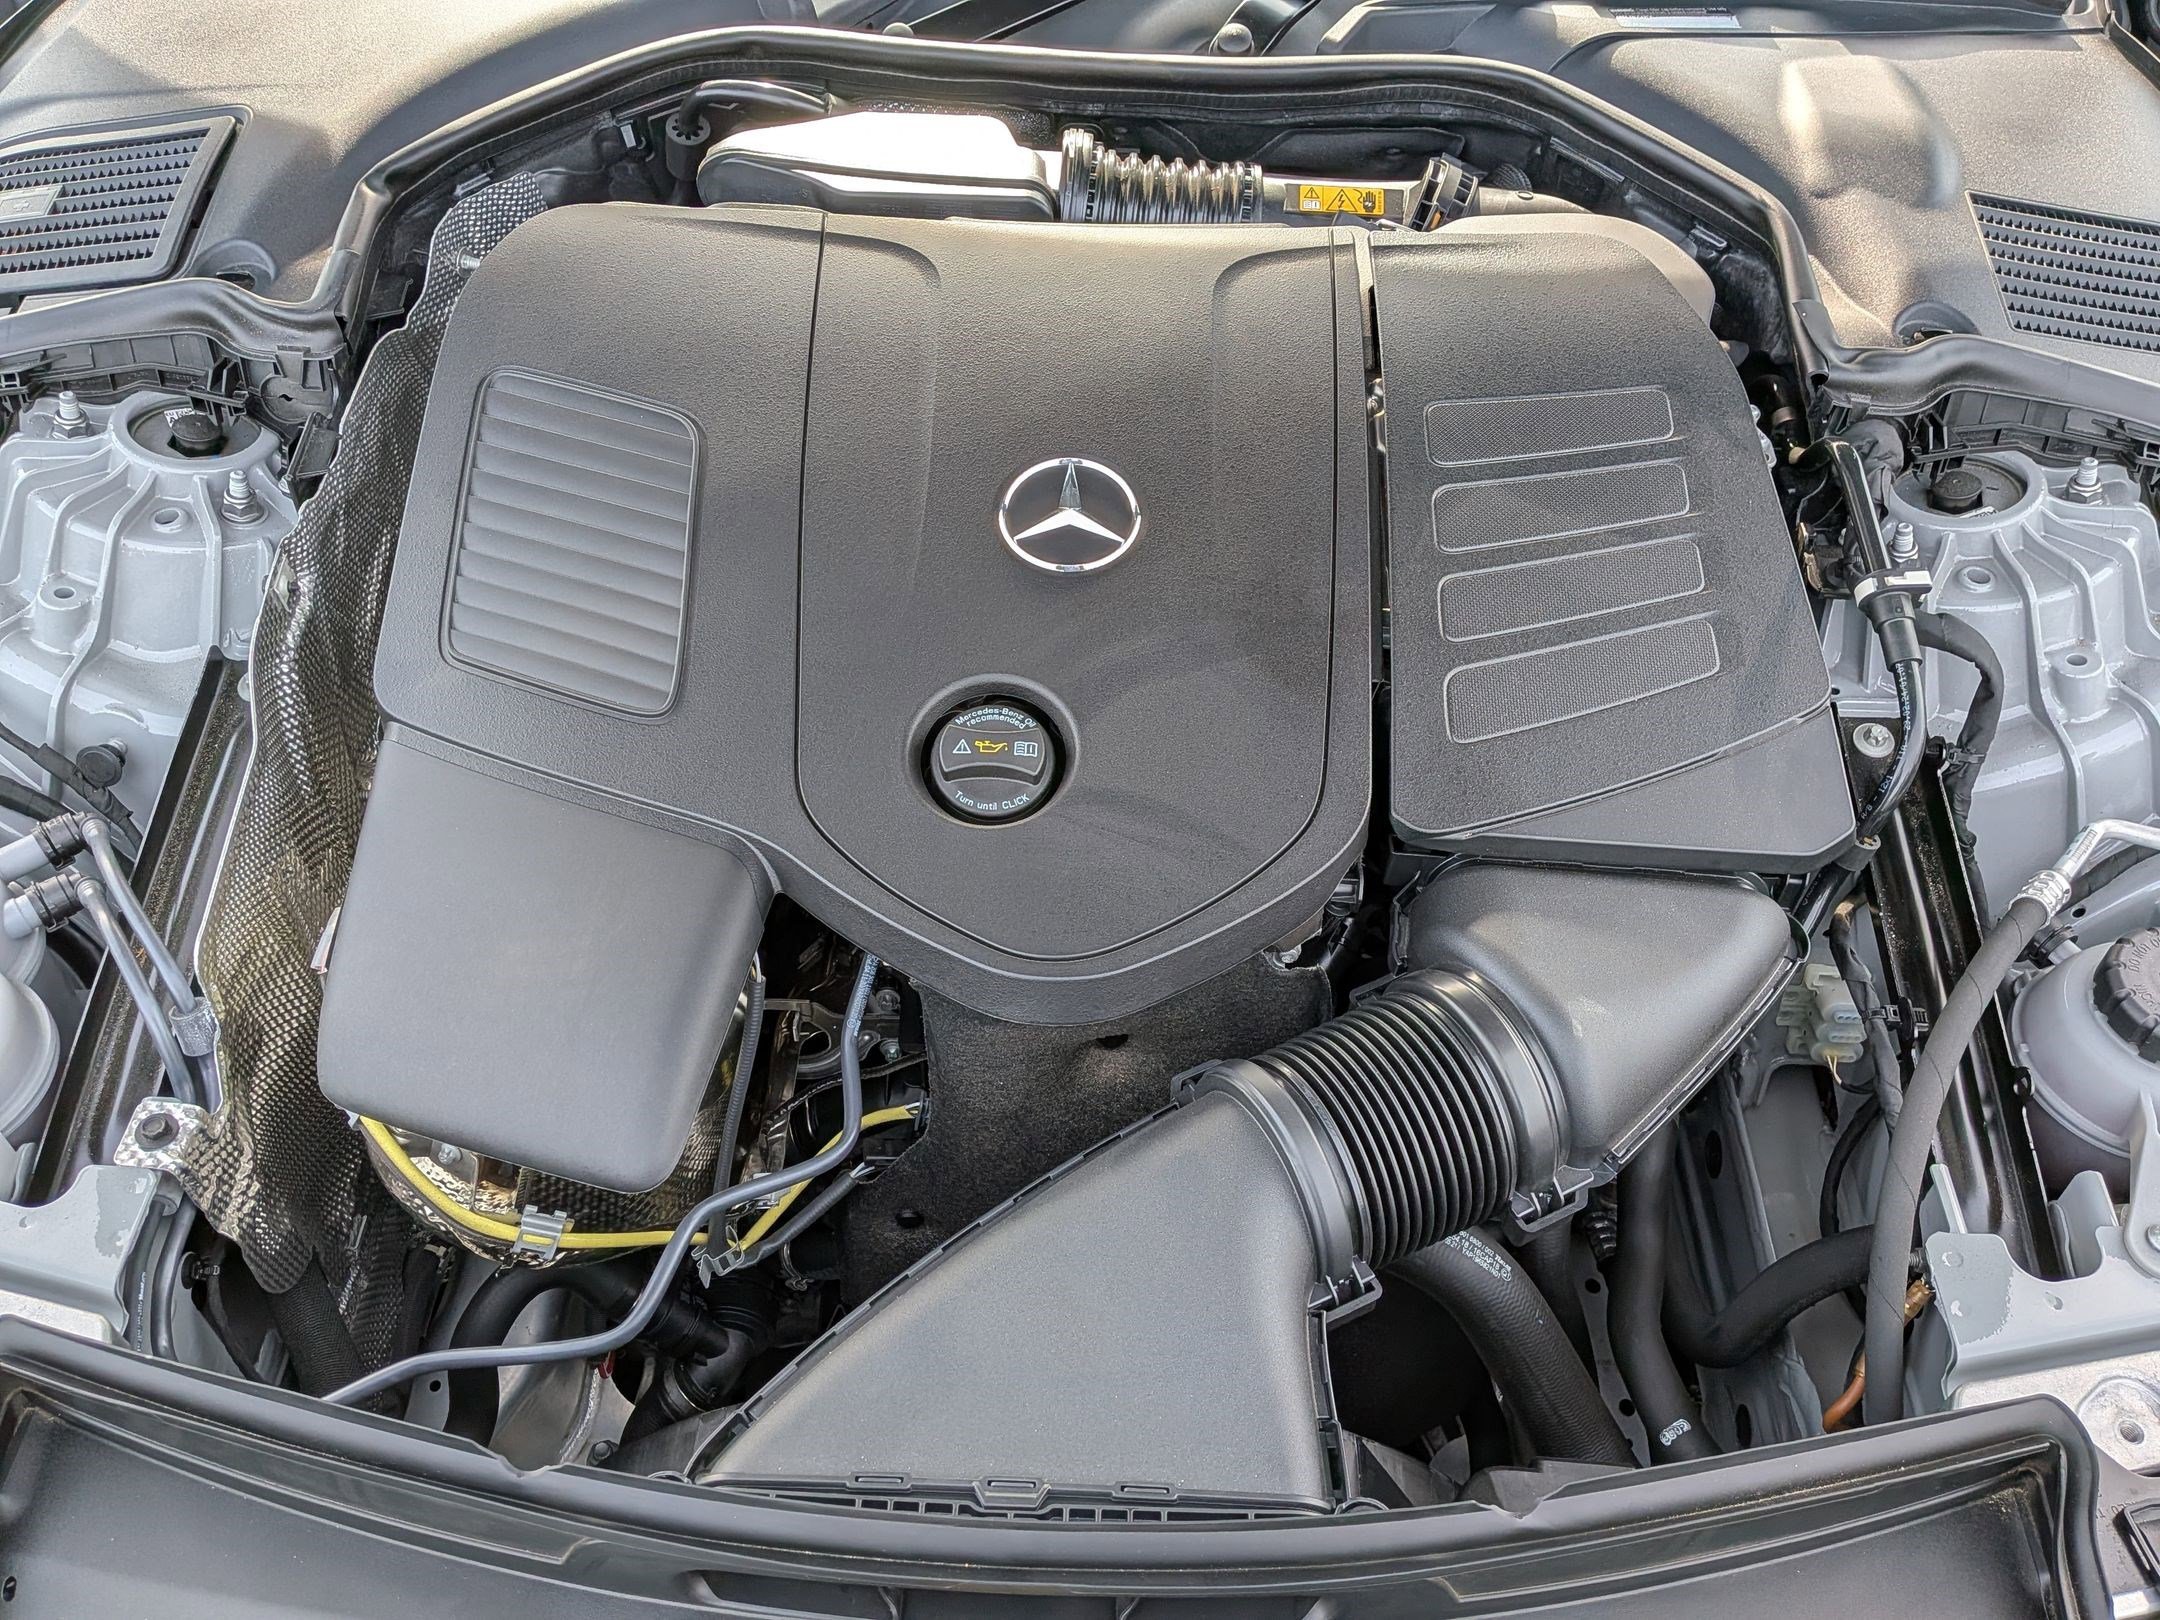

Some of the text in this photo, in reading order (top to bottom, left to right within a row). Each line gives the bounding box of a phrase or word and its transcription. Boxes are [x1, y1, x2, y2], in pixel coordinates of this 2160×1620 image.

[955, 707, 1037, 728] Mercedes-Benz Oil
[966, 713, 1027, 729] recommended
[955, 790, 1030, 811] Turn until CLICK
